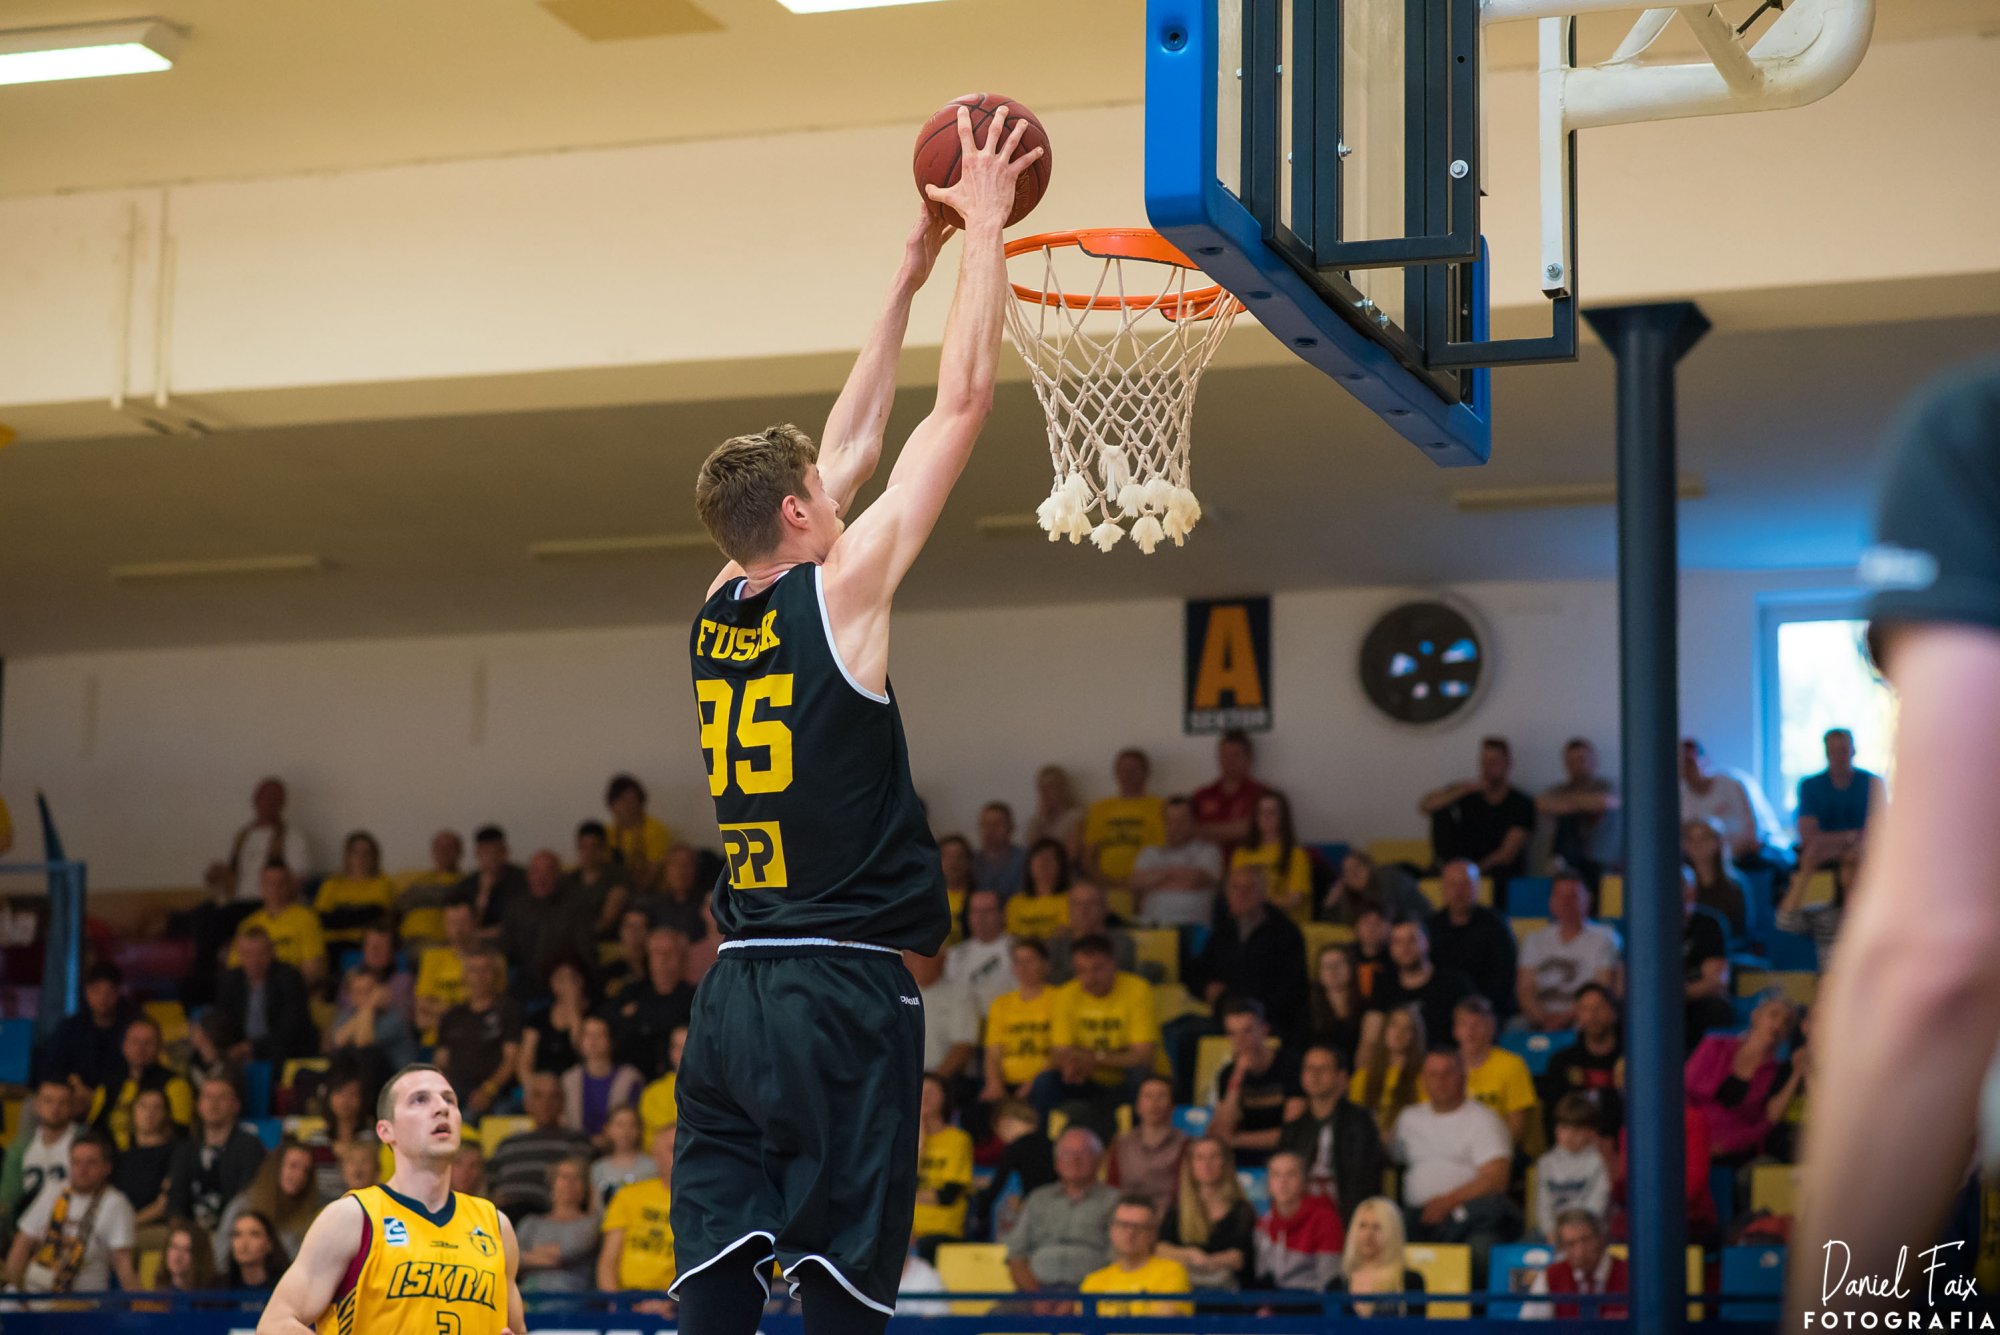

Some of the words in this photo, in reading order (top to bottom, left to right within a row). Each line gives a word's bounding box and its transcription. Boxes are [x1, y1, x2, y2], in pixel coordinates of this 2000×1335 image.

[697, 609, 780, 661] FUSK
[1194, 606, 1262, 709] A
[696, 673, 794, 797] 95
[387, 1261, 496, 1311] ISKRA
